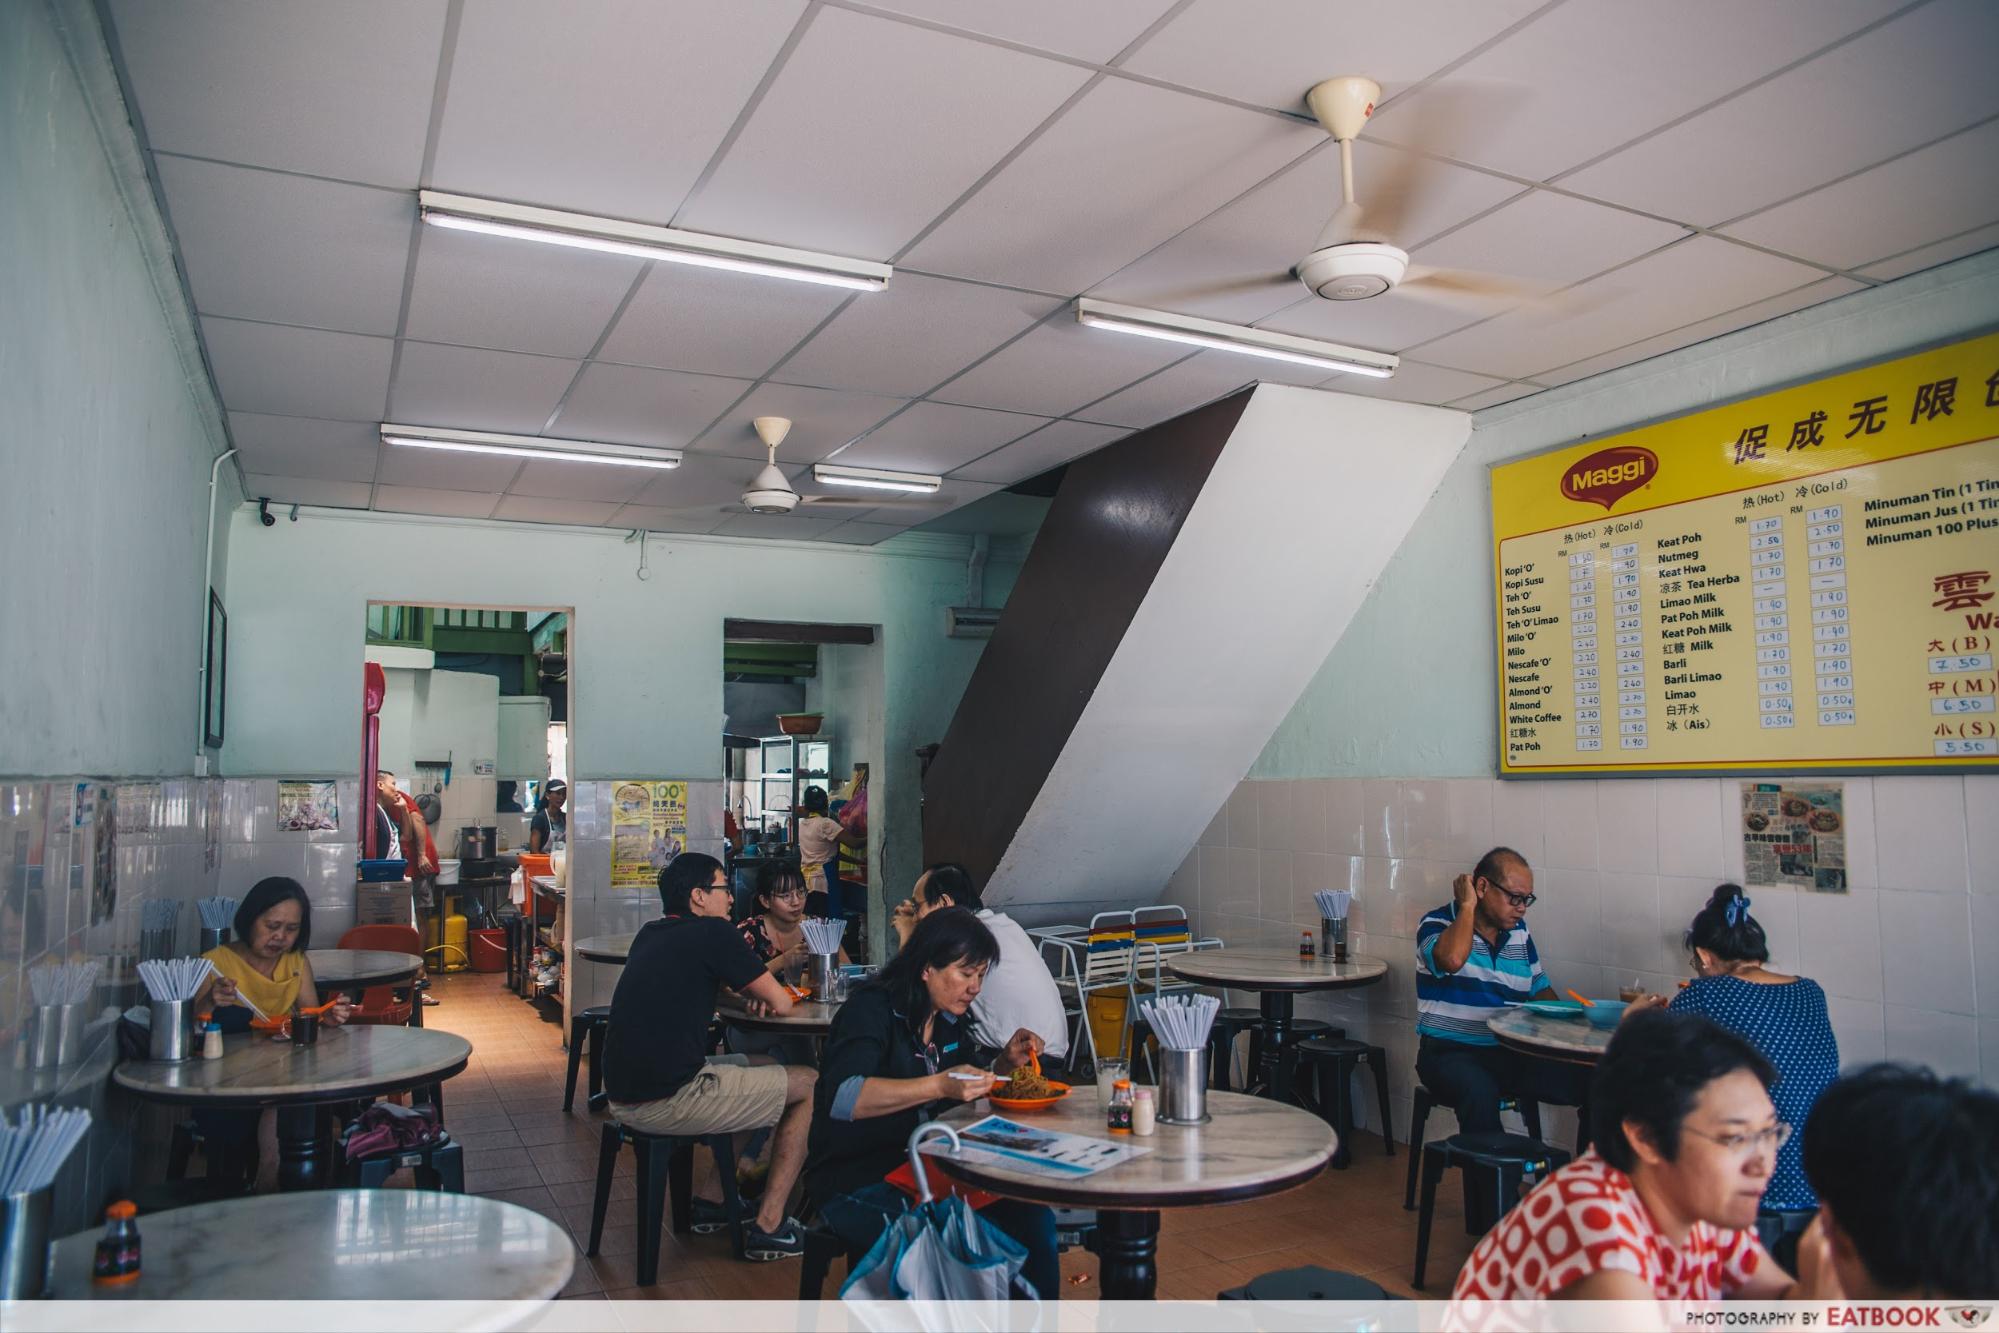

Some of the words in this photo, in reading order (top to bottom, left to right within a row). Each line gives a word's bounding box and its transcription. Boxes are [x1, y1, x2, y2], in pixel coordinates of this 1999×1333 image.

[1572, 456, 1645, 491] Maggi
[1865, 492, 1930, 512] Minuman
[1932, 488, 1955, 500] Tin
[1790, 506, 1803, 514] RM
[1735, 516, 1746, 524] RM
[1866, 510, 1930, 528] Minuman
[1934, 506, 1958, 518] Jus
[1866, 528, 1932, 546] Minuman
[1936, 522, 1962, 536] 100
[1966, 518, 1998, 531] Plus
[1657, 537, 1680, 548] Keat
[1682, 532, 1702, 544] Poh
[1658, 550, 1700, 564] Nutmeg
[1505, 564, 1522, 576] Kopi
[1659, 566, 1682, 578] Keat
[1683, 564, 1706, 576] Hwa
[1506, 578, 1524, 590] Kopi
[1525, 577, 1544, 587] Susu
[1687, 579, 1705, 590] Tea
[1707, 574, 1740, 586] Herba
[1932, 570, 1995, 612] 雲
[1506, 593, 1520, 602] Teh
[1660, 597, 1690, 609] Limao
[1693, 592, 1716, 604] Milk
[1506, 606, 1520, 616] Teh
[1522, 604, 1541, 614] Susu
[1661, 612, 1678, 624] Pat
[1680, 609, 1700, 622] Poh
[1701, 607, 1724, 618] Milk
[1506, 620, 1520, 630] Teh
[1533, 616, 1559, 626] Limao
[1662, 628, 1685, 640] Keat
[1686, 624, 1706, 636] Poh
[1708, 622, 1732, 634] Milk
[1507, 633, 1524, 642] Milo
[1690, 640, 1714, 651] Milk
[1508, 648, 1525, 656] Milo
[1508, 660, 1539, 670] Nescafe
[1663, 658, 1686, 670] Barli
[1508, 673, 1540, 683] Nescafe
[1664, 674, 1688, 684] Barli
[1690, 672, 1722, 682] Limao
[1508, 687, 1540, 696] Almond
[1665, 690, 1696, 700] Limao
[1509, 700, 1540, 710] Almond
[1510, 714, 1533, 724] White
[1534, 713, 1562, 722] Coffee
[1510, 742, 1524, 751] Pat
[1525, 741, 1540, 750] Poh
